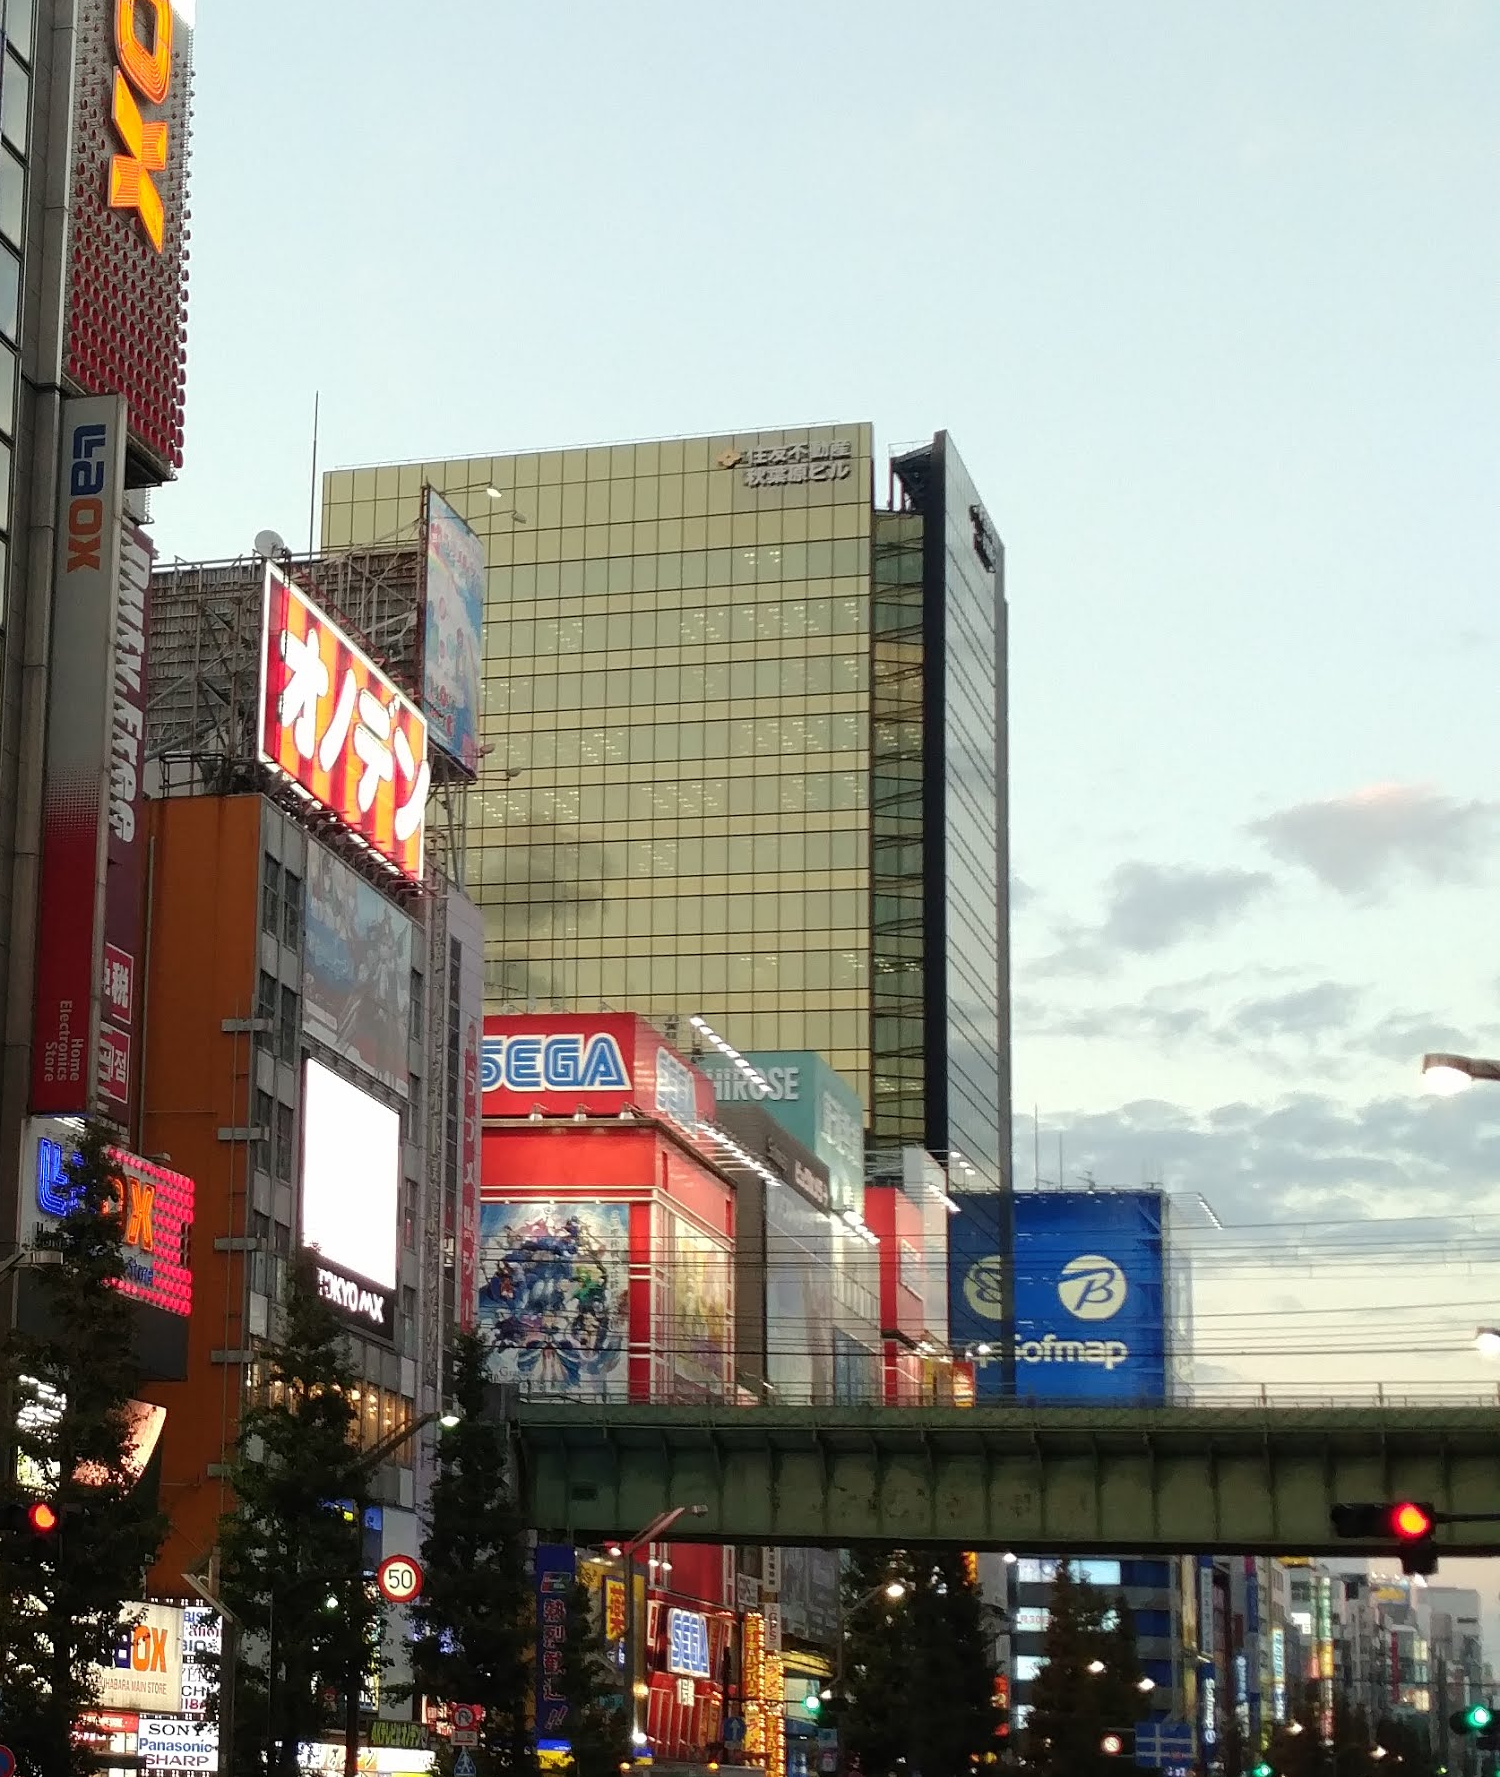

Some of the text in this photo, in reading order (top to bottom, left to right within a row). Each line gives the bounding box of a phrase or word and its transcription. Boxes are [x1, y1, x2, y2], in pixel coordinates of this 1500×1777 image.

[279, 628, 430, 841] オノデン
[57, 1000, 73, 1082] Electronics
[44, 1041, 58, 1082] Store
[69, 1038, 84, 1082] Home
[358, 1290, 385, 1324] MX
[388, 1569, 414, 1589] 50
[138, 1737, 213, 1753] Panasonic
[148, 1723, 204, 1737] SONY
[145, 1753, 210, 1767] SHARP
